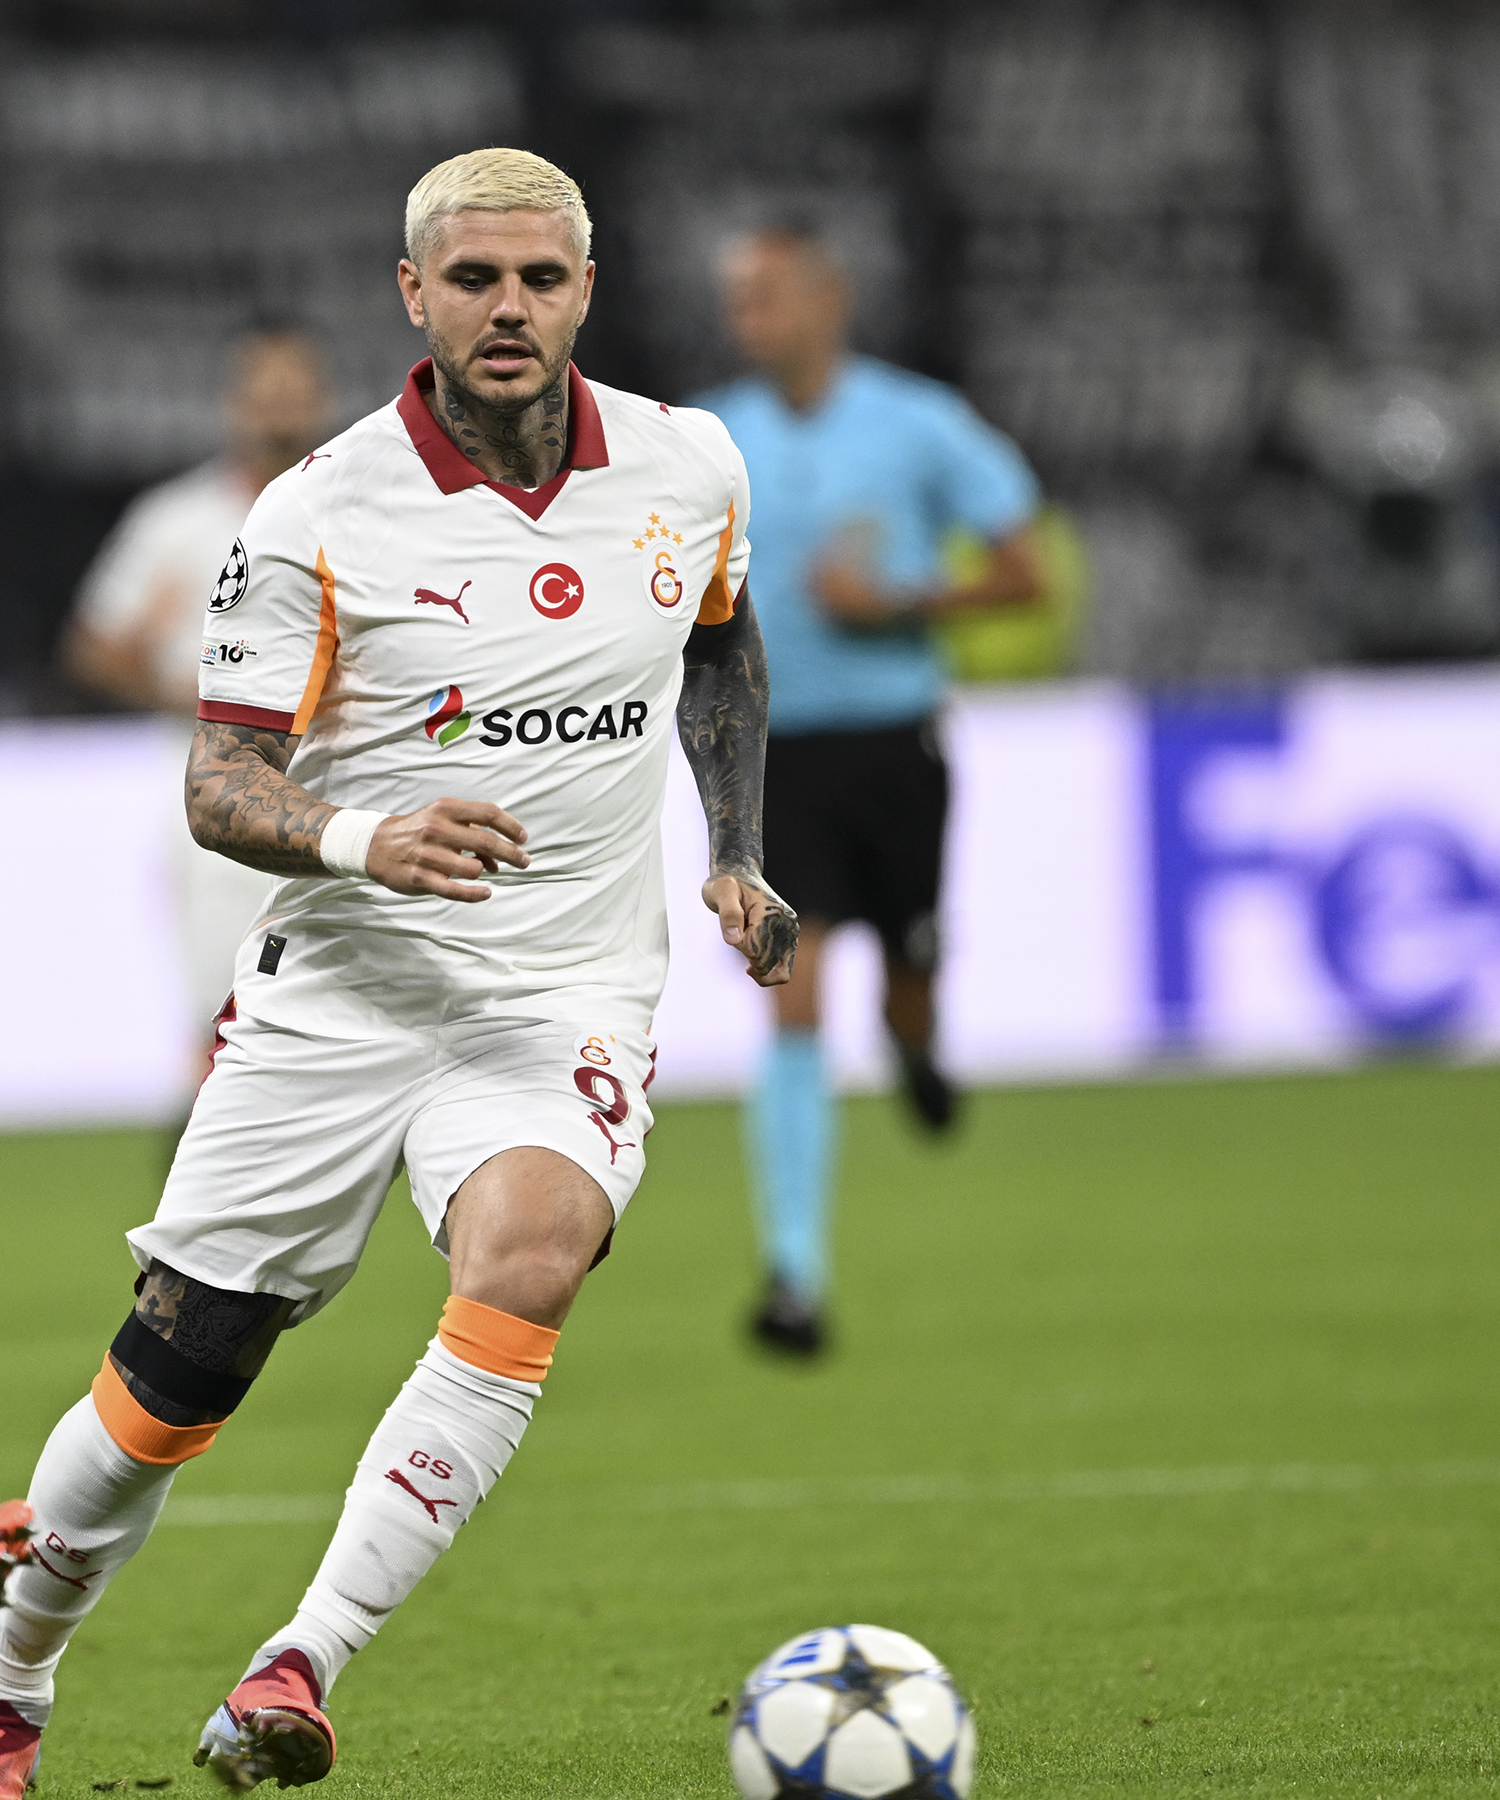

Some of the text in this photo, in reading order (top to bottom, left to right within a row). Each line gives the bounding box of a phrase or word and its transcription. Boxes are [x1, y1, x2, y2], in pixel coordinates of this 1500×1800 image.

[219, 644, 244, 663] 10
[479, 700, 648, 747] SOCAR
[573, 1066, 631, 1127] 9
[408, 1450, 454, 1480] GS
[45, 1531, 91, 1564] GS
